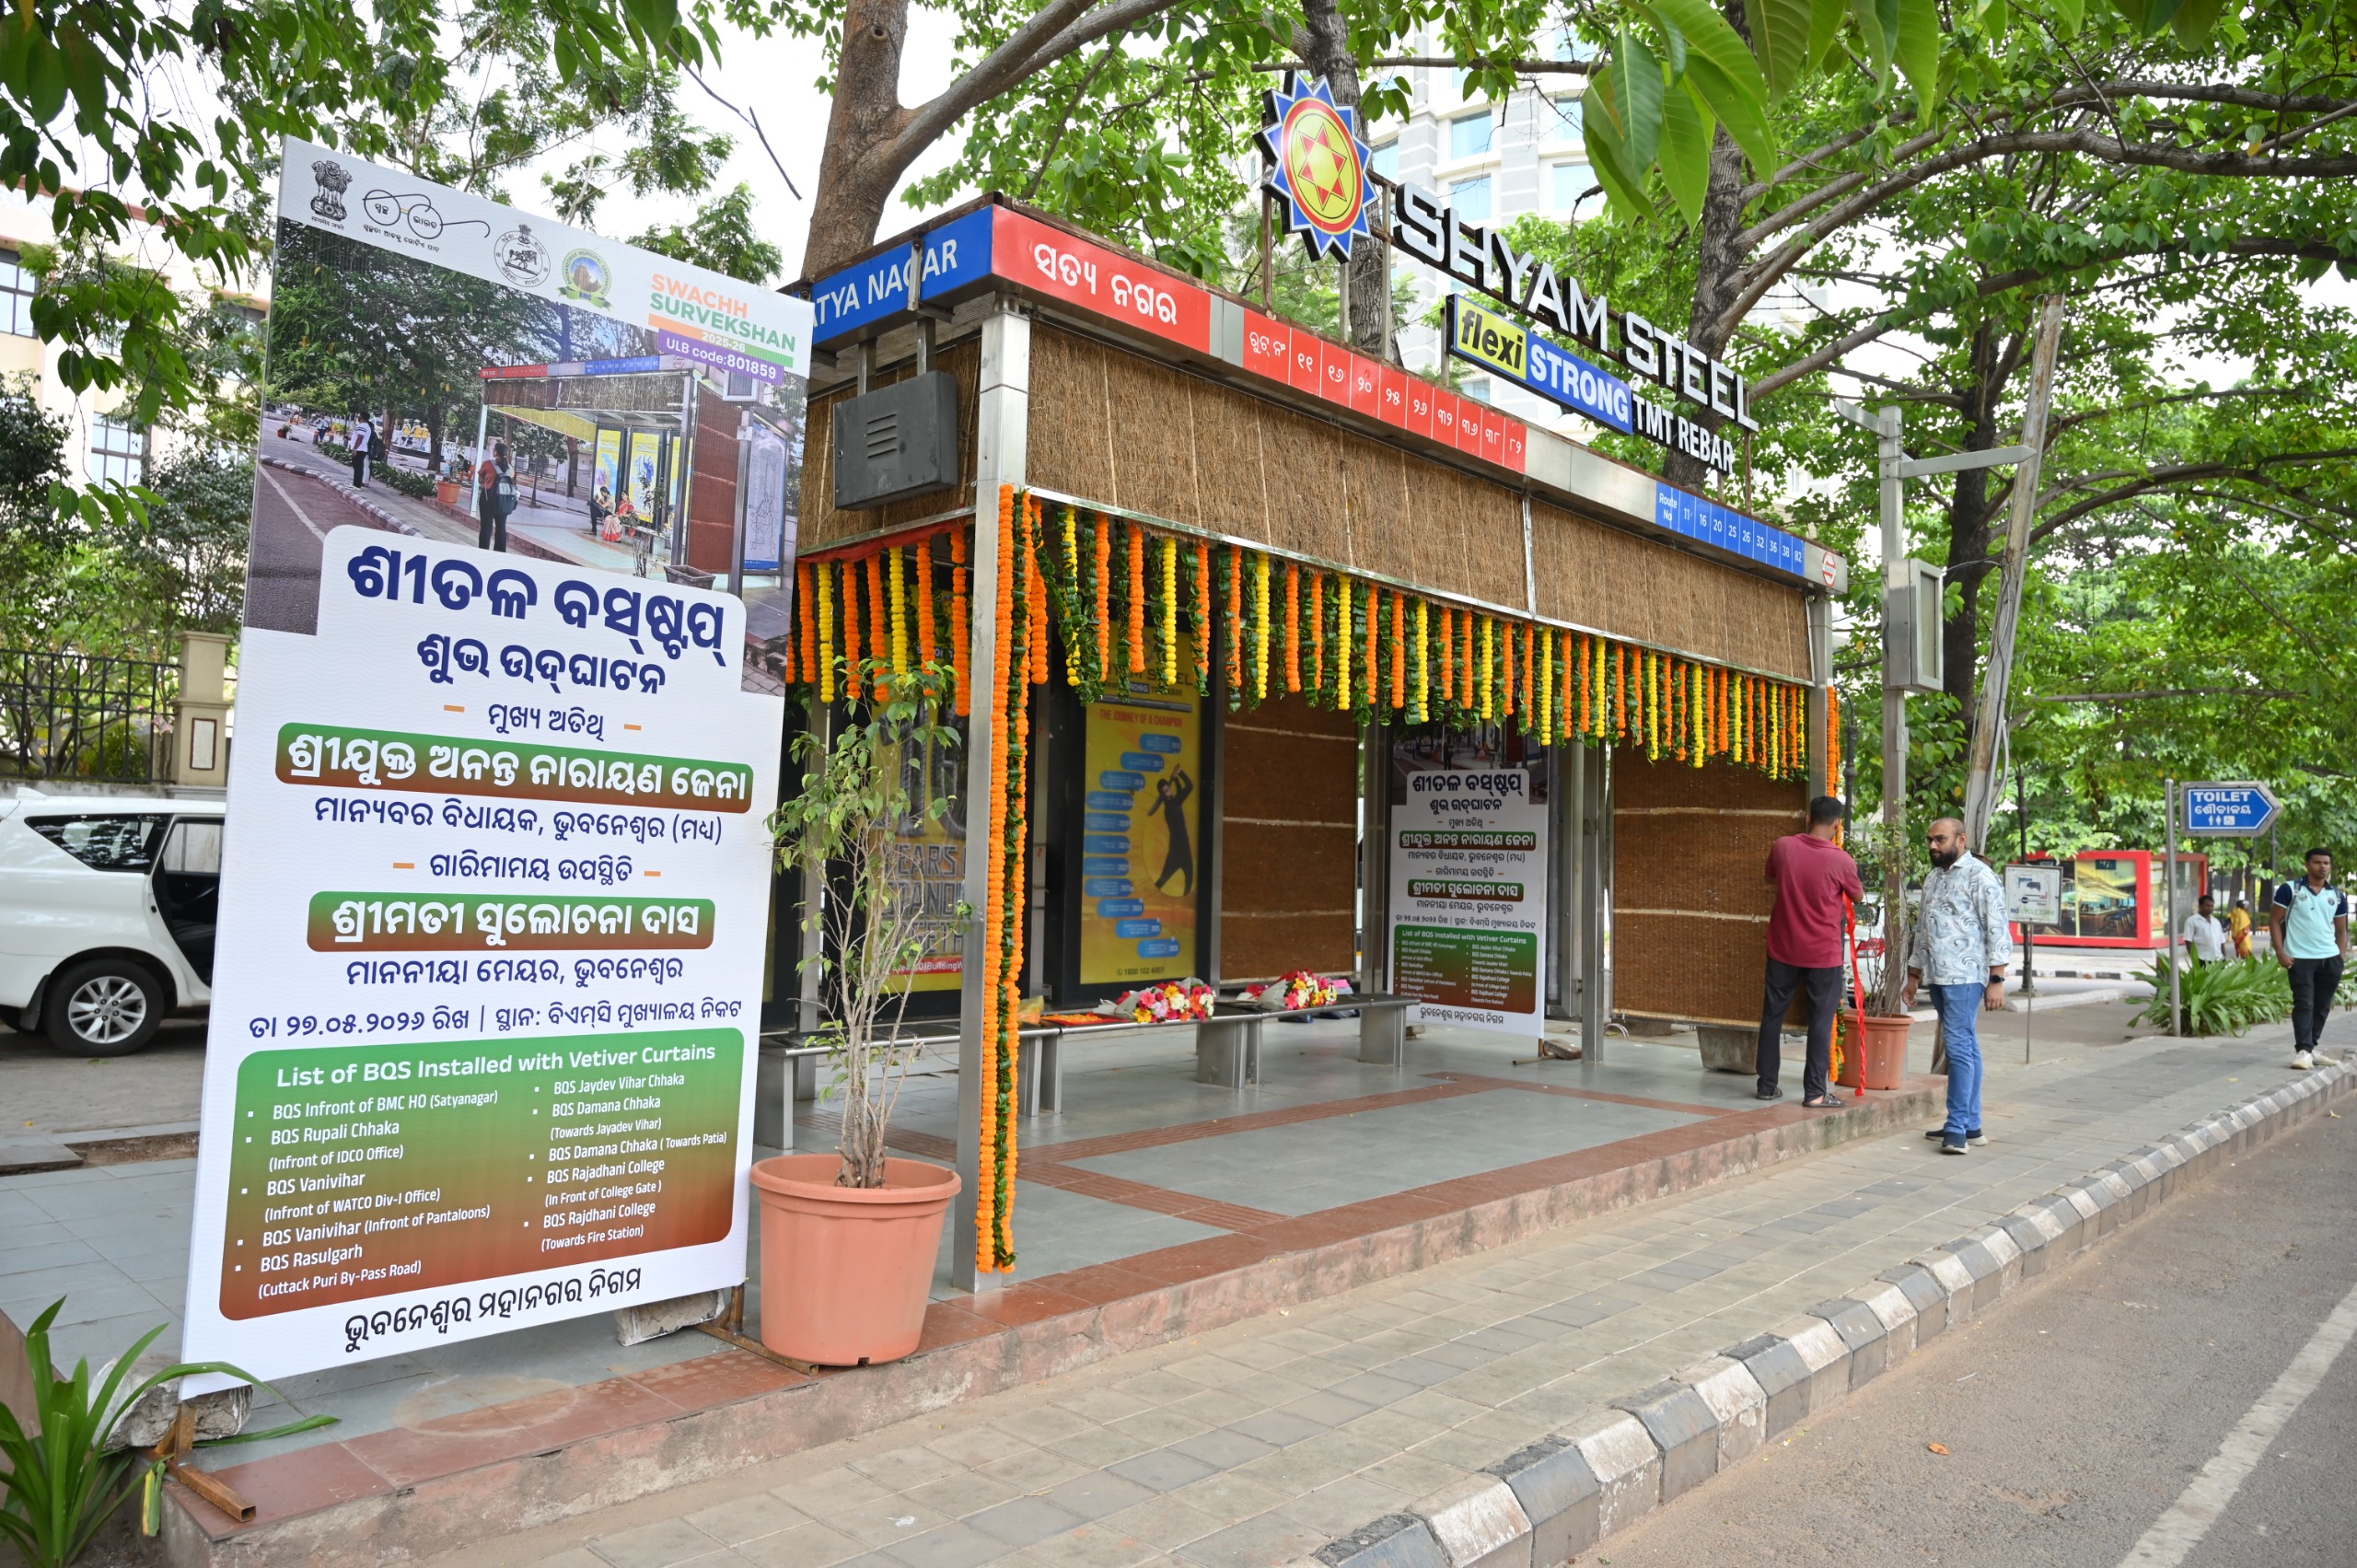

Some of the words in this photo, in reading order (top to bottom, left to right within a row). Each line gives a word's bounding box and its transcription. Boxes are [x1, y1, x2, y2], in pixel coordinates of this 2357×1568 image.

[652, 274, 748, 319] SWACHH
[1034, 244, 1097, 295] ସତ୍ୟ
[1111, 274, 1177, 325] ନଗର
[650, 292, 795, 352] SURVEKSHAN
[1397, 182, 1608, 352] SHYAM
[1622, 311, 1759, 432] STEEL
[667, 338, 690, 354] ULB
[692, 348, 776, 379] code:801859
[702, 331, 746, 353] 2025-26
[1249, 331, 1270, 356] ରୁଟ୍
[1273, 342, 1286, 356] ନଂ
[1297, 353, 1313, 372] ୧୧
[1329, 366, 1344, 382] ୧୬
[1357, 377, 1372, 392] ୨୦
[1386, 388, 1400, 405] ୨୫
[1413, 399, 1427, 415] ୨୬
[1438, 409, 1453, 426] ୩୨
[1461, 419, 1478, 436] ୩୬
[1485, 428, 1501, 445] ୩୮
[1509, 438, 1522, 453] ୮୨
[1462, 309, 1523, 369] flexi
[1530, 344, 1629, 424] STRONG
[1632, 393, 1673, 445] TMT
[1678, 416, 1734, 474] REBAR
[1659, 493, 1678, 508] Route
[1663, 509, 1672, 521] No
[1683, 507, 1690, 521] 11
[1700, 514, 1707, 527] 16
[1713, 518, 1723, 532] 20
[1728, 525, 1737, 538] 25
[1742, 530, 1751, 542] 26
[1756, 535, 1764, 549] 32
[1770, 540, 1778, 552] 36
[1782, 545, 1790, 558] 38
[1794, 550, 1802, 563] 82
[348, 546, 537, 620] ଶୀତଳ
[417, 633, 490, 685] ଶୁଭ
[549, 707, 604, 742] ଅତିଥି
[1100, 709, 1111, 720] THE
[1113, 711, 1139, 723] JOURNEY
[288, 733, 417, 786] ଶ୍ରୀଯୁକ୍ତ
[429, 745, 520, 787] ଅନନ୍ତ
[672, 766, 748, 800] ଜେନା
[2194, 792, 2250, 802] TOILET
[558, 854, 632, 886] ଉପସ୍ଥିତି
[332, 900, 464, 943] ଶ୍ରୀମତୀ
[476, 903, 632, 946] ସୁଲୋଚନା
[642, 906, 699, 935] ଦାସ
[250, 1017, 276, 1038] ତା
[287, 1012, 424, 1036] ୨୭.୦୫.୨୦୨୬
[433, 1006, 469, 1029] ରିଖ
[495, 1008, 540, 1031] ସ୍ଥାନ:
[702, 996, 741, 1018] ନିକଟ
[278, 1067, 324, 1086] List
[331, 1063, 357, 1083] of
[364, 1062, 411, 1081] BQS
[418, 1055, 512, 1077] Installed
[518, 1052, 563, 1071] with
[569, 1050, 637, 1068] Vetiver
[643, 1044, 714, 1063] Curtains
[554, 1081, 575, 1094] BQS
[578, 1078, 616, 1095] Jaydev
[619, 1076, 646, 1089] Vihar
[648, 1073, 684, 1086] Chhaka
[273, 1103, 301, 1120] BQS
[306, 1098, 356, 1118] Infront
[359, 1097, 375, 1113] of
[377, 1096, 405, 1111] BMC
[409, 1094, 426, 1109] HO
[430, 1090, 497, 1109] (Satyanagar)
[552, 1103, 574, 1117] BQS
[577, 1101, 621, 1114] Damana
[623, 1096, 660, 1110] Chhaka
[272, 1129, 299, 1145] BQS
[304, 1124, 347, 1144] Rupali
[352, 1121, 400, 1137] Chhaka
[549, 1147, 571, 1161] BQS
[575, 1144, 618, 1158] Damana
[621, 1138, 657, 1153] Chhaka
[666, 1134, 701, 1148] Towards
[703, 1132, 726, 1144] Patia)
[551, 1124, 594, 1141] (Towards
[597, 1121, 633, 1135] Jayadev
[635, 1118, 661, 1131] Vihar)
[269, 1153, 317, 1173] (Infront
[320, 1151, 334, 1166] of
[337, 1149, 364, 1163] IDCO
[366, 1144, 403, 1160] Office)
[547, 1169, 569, 1183] BQS
[573, 1162, 625, 1182] Rajadhani
[628, 1159, 665, 1174] College
[267, 1179, 295, 1195] BQS
[300, 1173, 366, 1191] Vanivihar
[265, 1202, 313, 1223] (Infront
[317, 1201, 330, 1215] of
[333, 1196, 372, 1212] WATCO
[376, 1193, 401, 1207] Div-I
[405, 1188, 440, 1203] Office)
[543, 1214, 565, 1228] BQS
[569, 1206, 616, 1225] Rajdhani
[619, 1202, 656, 1217] College
[263, 1229, 291, 1247] BQS
[296, 1222, 361, 1241] Vanivihar
[365, 1215, 410, 1235] (Infront
[412, 1214, 424, 1227] of
[427, 1204, 490, 1225] Pantaloons)
[541, 1234, 586, 1252] (Towards
[587, 1232, 605, 1243] Fire
[608, 1225, 644, 1240] Station)
[261, 1254, 289, 1272] BQS
[294, 1244, 363, 1267] Rasulgarh
[259, 1278, 309, 1299] (Cuttack
[313, 1272, 337, 1288] Puri
[341, 1268, 387, 1285] By-Pass
[389, 1260, 421, 1276] Road)
[479, 1279, 582, 1318] ମହାନଗର
[589, 1268, 641, 1297] ନିଗମ
